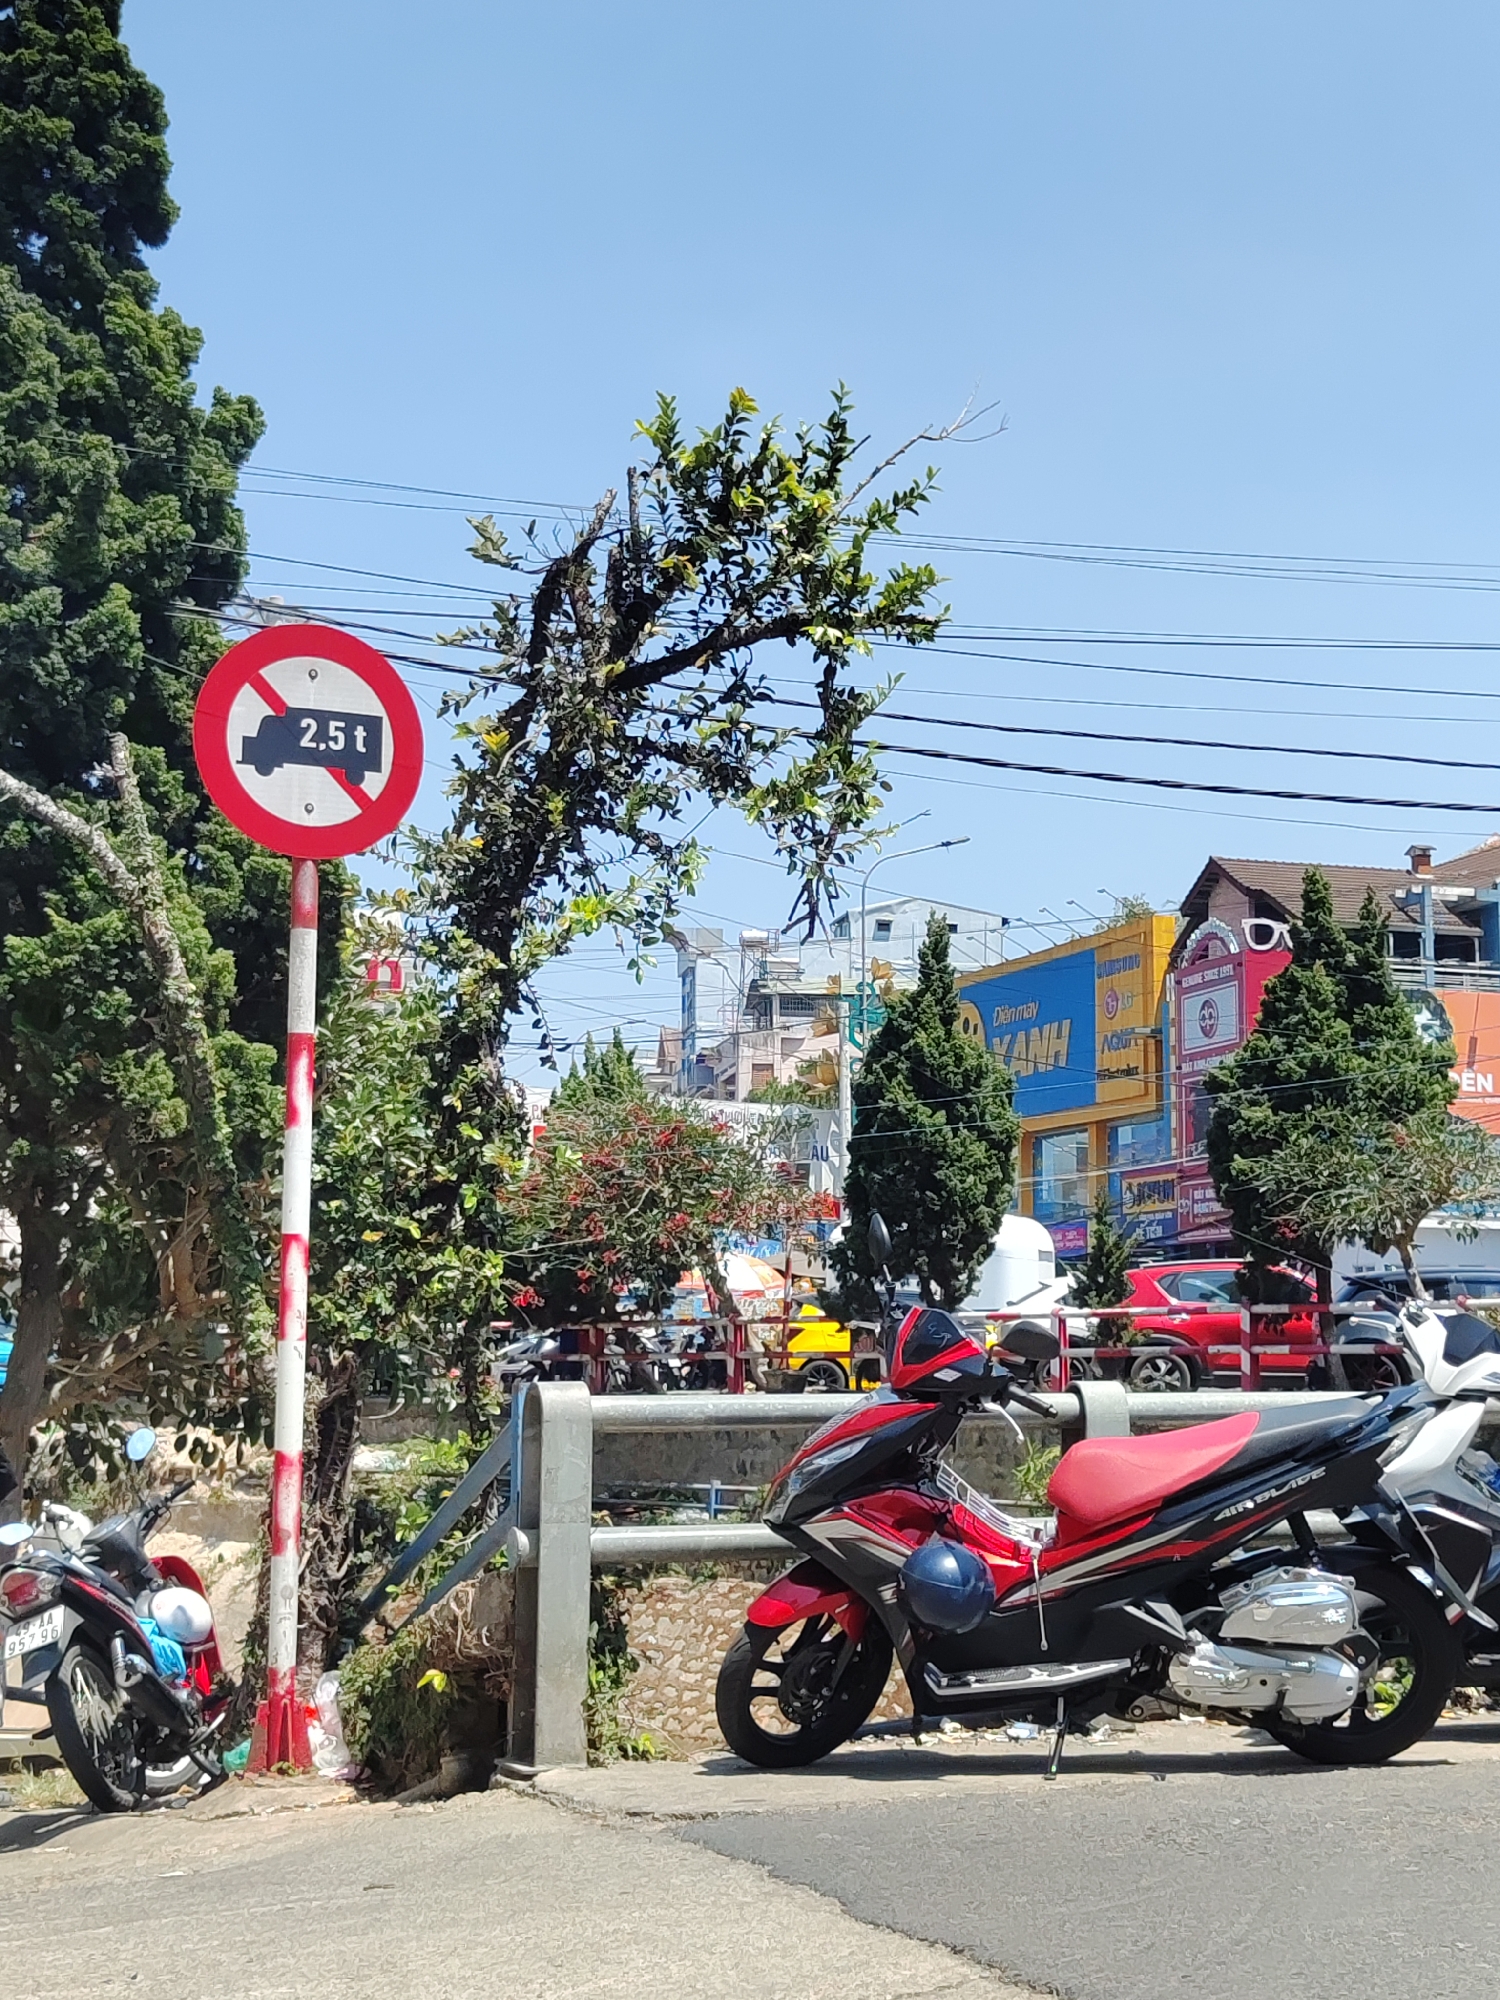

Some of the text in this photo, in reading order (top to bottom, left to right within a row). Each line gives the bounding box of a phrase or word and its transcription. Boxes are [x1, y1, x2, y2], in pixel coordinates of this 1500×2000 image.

[992, 1018, 1072, 1077] XANH
[1213, 1466, 1327, 1522] AIR BLADE
